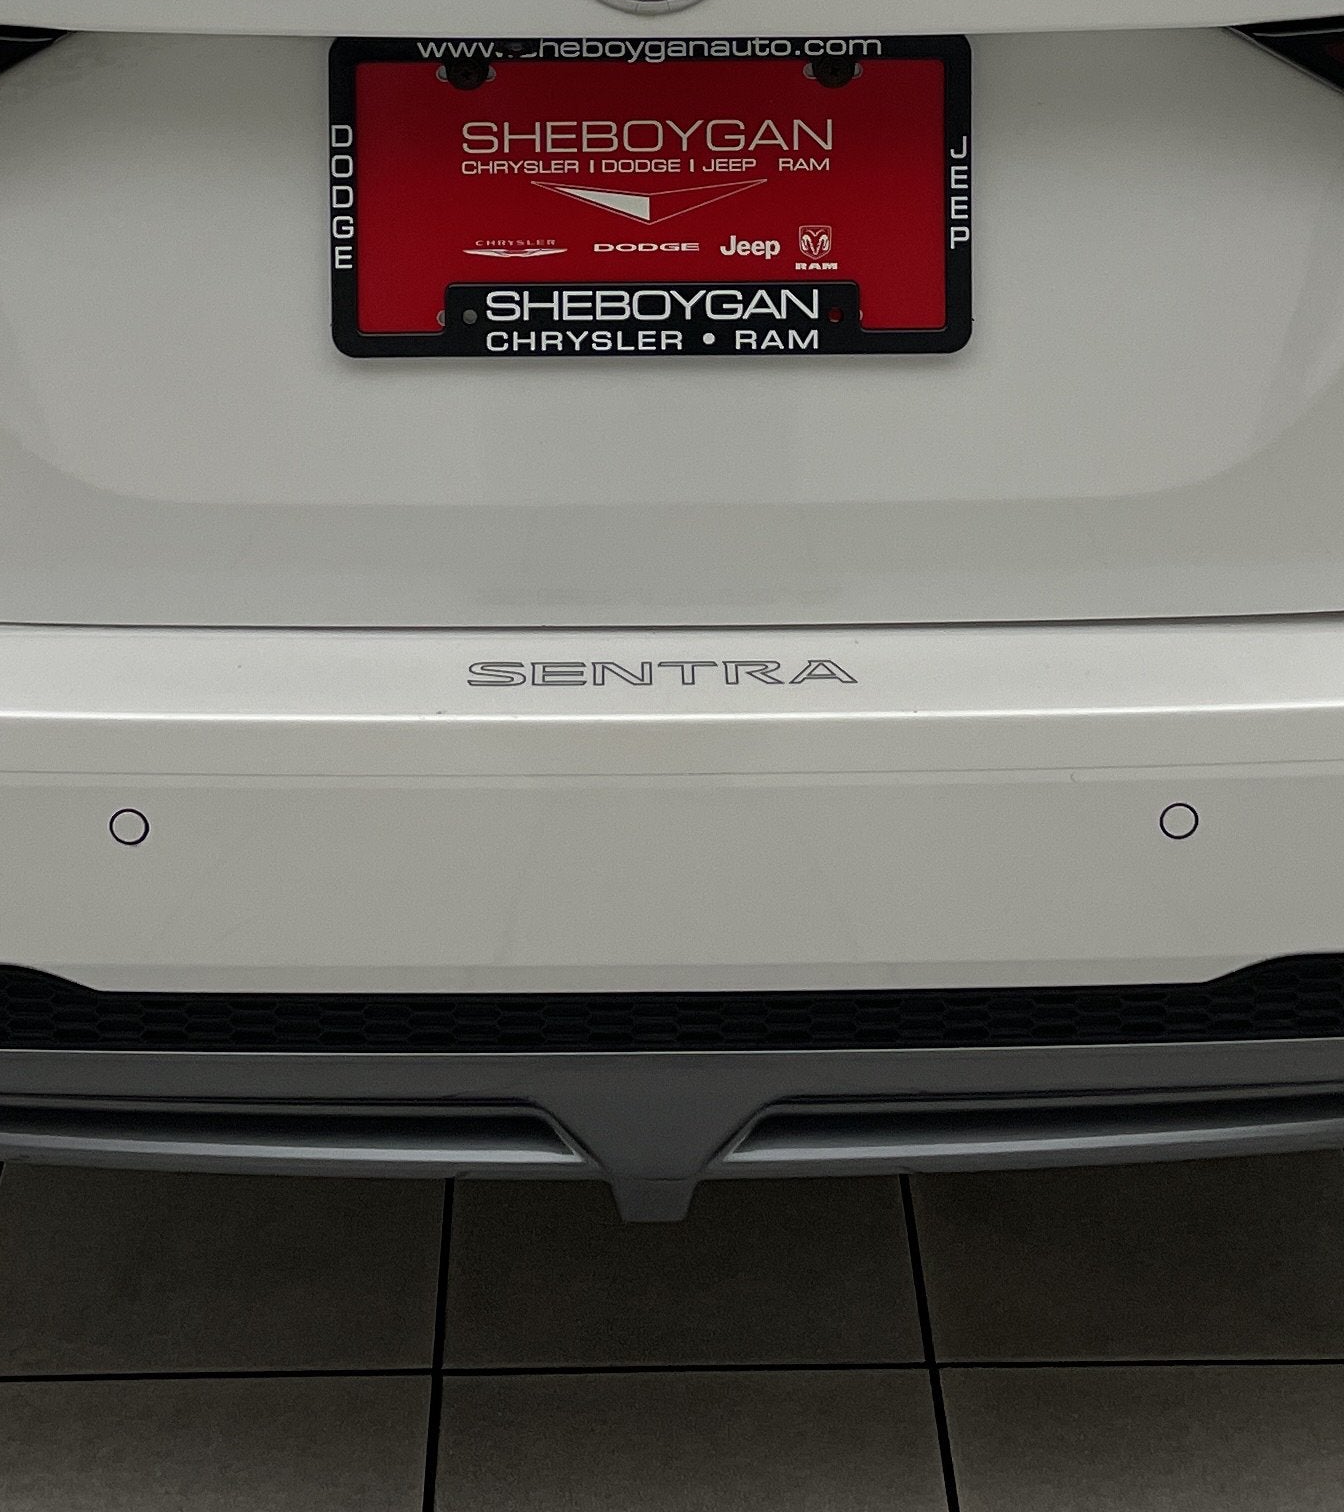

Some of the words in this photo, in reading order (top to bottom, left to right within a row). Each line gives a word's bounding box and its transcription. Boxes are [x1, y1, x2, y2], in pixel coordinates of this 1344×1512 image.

[417, 37, 882, 63] www.heboyganauto.com
[462, 119, 833, 154] SHEBOYGAN
[461, 160, 579, 175] CHRYSLER
[601, 159, 681, 173] DODGE
[702, 158, 757, 172] JEEP
[778, 157, 830, 172] RAM
[331, 124, 354, 269] DODGE
[950, 135, 970, 250] JEEP
[475, 239, 556, 247] CHRYSLER
[593, 242, 700, 253] DODGE
[719, 235, 781, 260] Jeep
[795, 262, 838, 270] RAM
[486, 289, 819, 321] SHEBOYGAN
[486, 330, 683, 352] CHRYSLER
[735, 329, 819, 350] RAM
[467, 659, 858, 687] SENTRA
